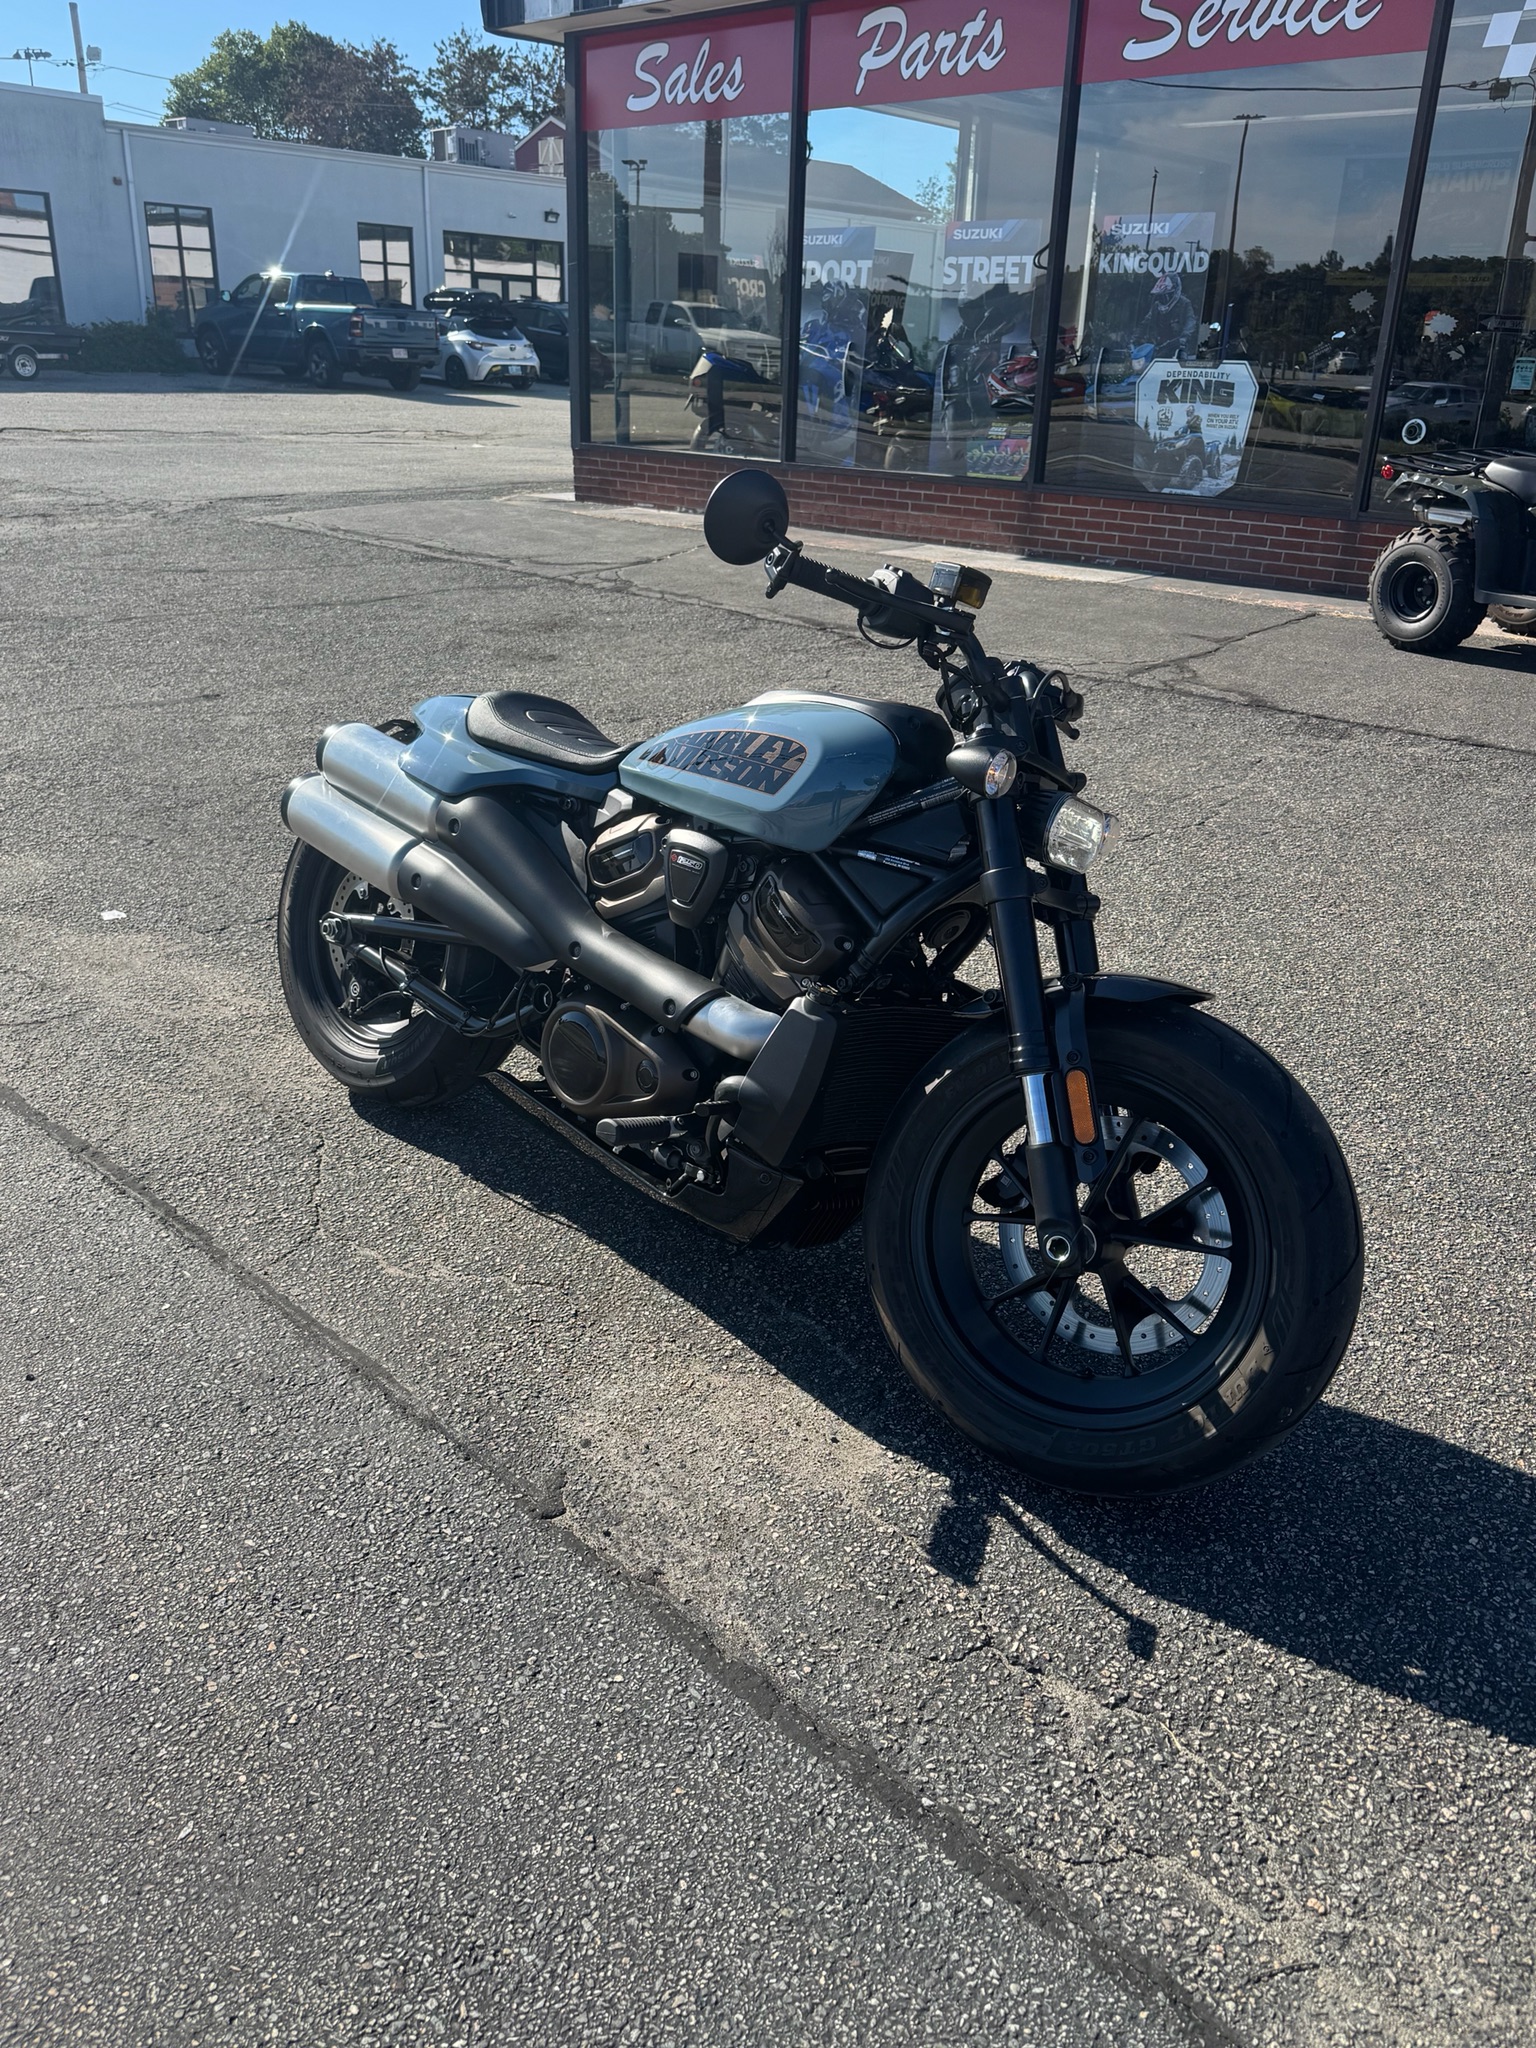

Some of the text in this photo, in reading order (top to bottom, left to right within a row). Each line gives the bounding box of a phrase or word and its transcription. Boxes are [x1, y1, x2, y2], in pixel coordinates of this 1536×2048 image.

[855, 6, 1006, 96] Parts
[625, 38, 745, 112] Sales
[1423, 169, 1511, 193] HAMP
[802, 234, 843, 246] SUZUKI
[953, 228, 1003, 240] SUZUKI
[1111, 222, 1170, 235] SUZUKI
[801, 259, 873, 289] PORT
[943, 254, 1035, 286] STREET
[1098, 251, 1210, 278] KINGQUAD
[870, 293, 906, 309] OURING
[1166, 370, 1231, 379] DEPENDABILITY
[1157, 379, 1235, 408] KING
